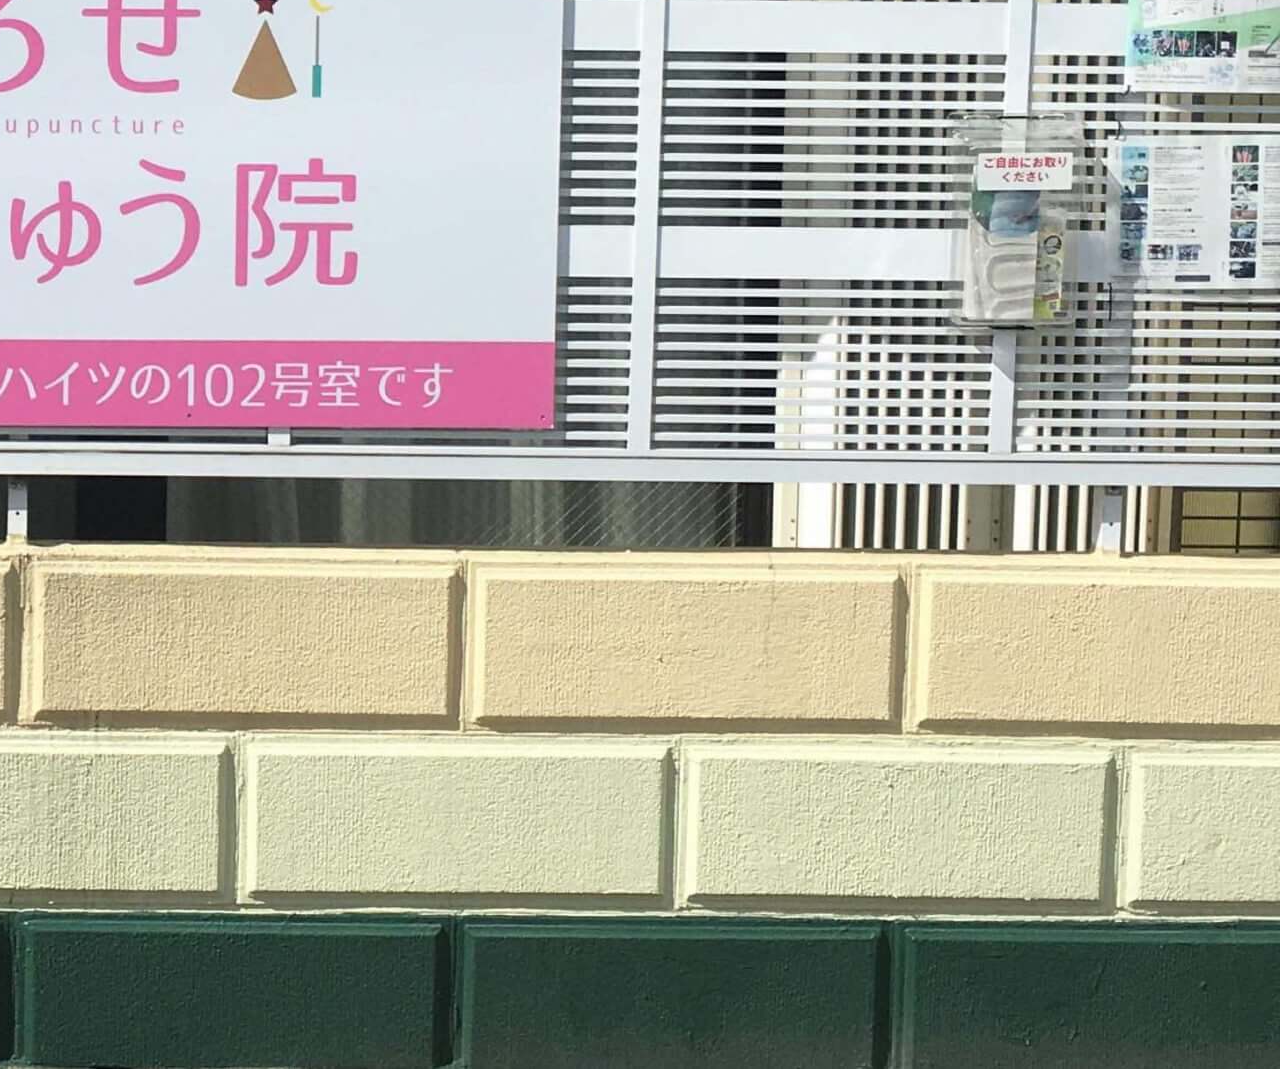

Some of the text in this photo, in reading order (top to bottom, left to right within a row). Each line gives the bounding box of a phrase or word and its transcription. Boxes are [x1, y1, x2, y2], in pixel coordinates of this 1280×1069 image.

[984, 156, 1067, 169] ご自由にお取り
[1002, 171, 1049, 183] ください
